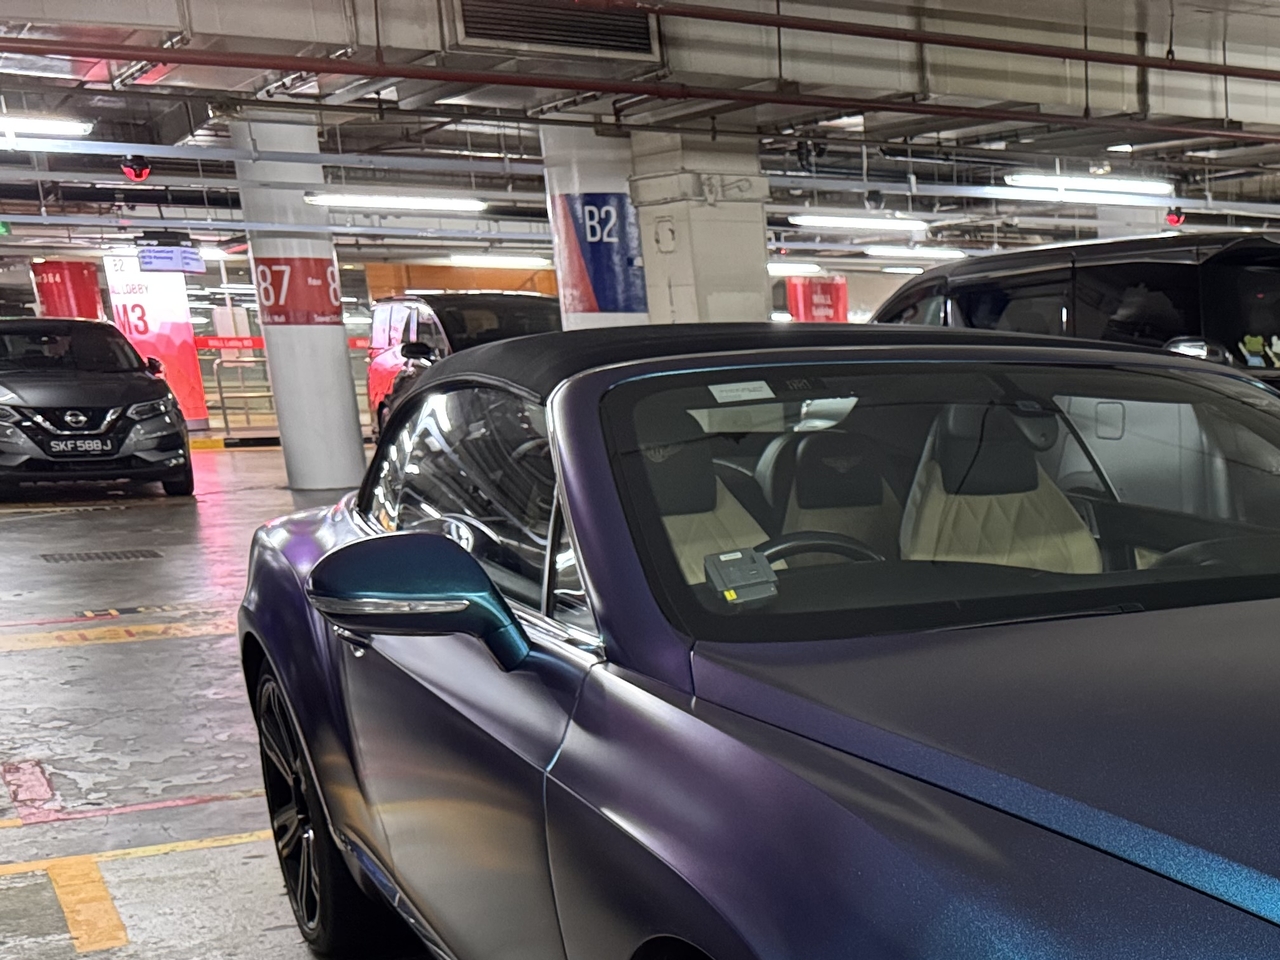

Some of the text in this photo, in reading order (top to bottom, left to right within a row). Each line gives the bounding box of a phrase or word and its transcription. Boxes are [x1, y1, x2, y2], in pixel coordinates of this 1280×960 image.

[584, 205, 619, 243] B2
[257, 264, 291, 307] 87
[114, 303, 150, 336] M3
